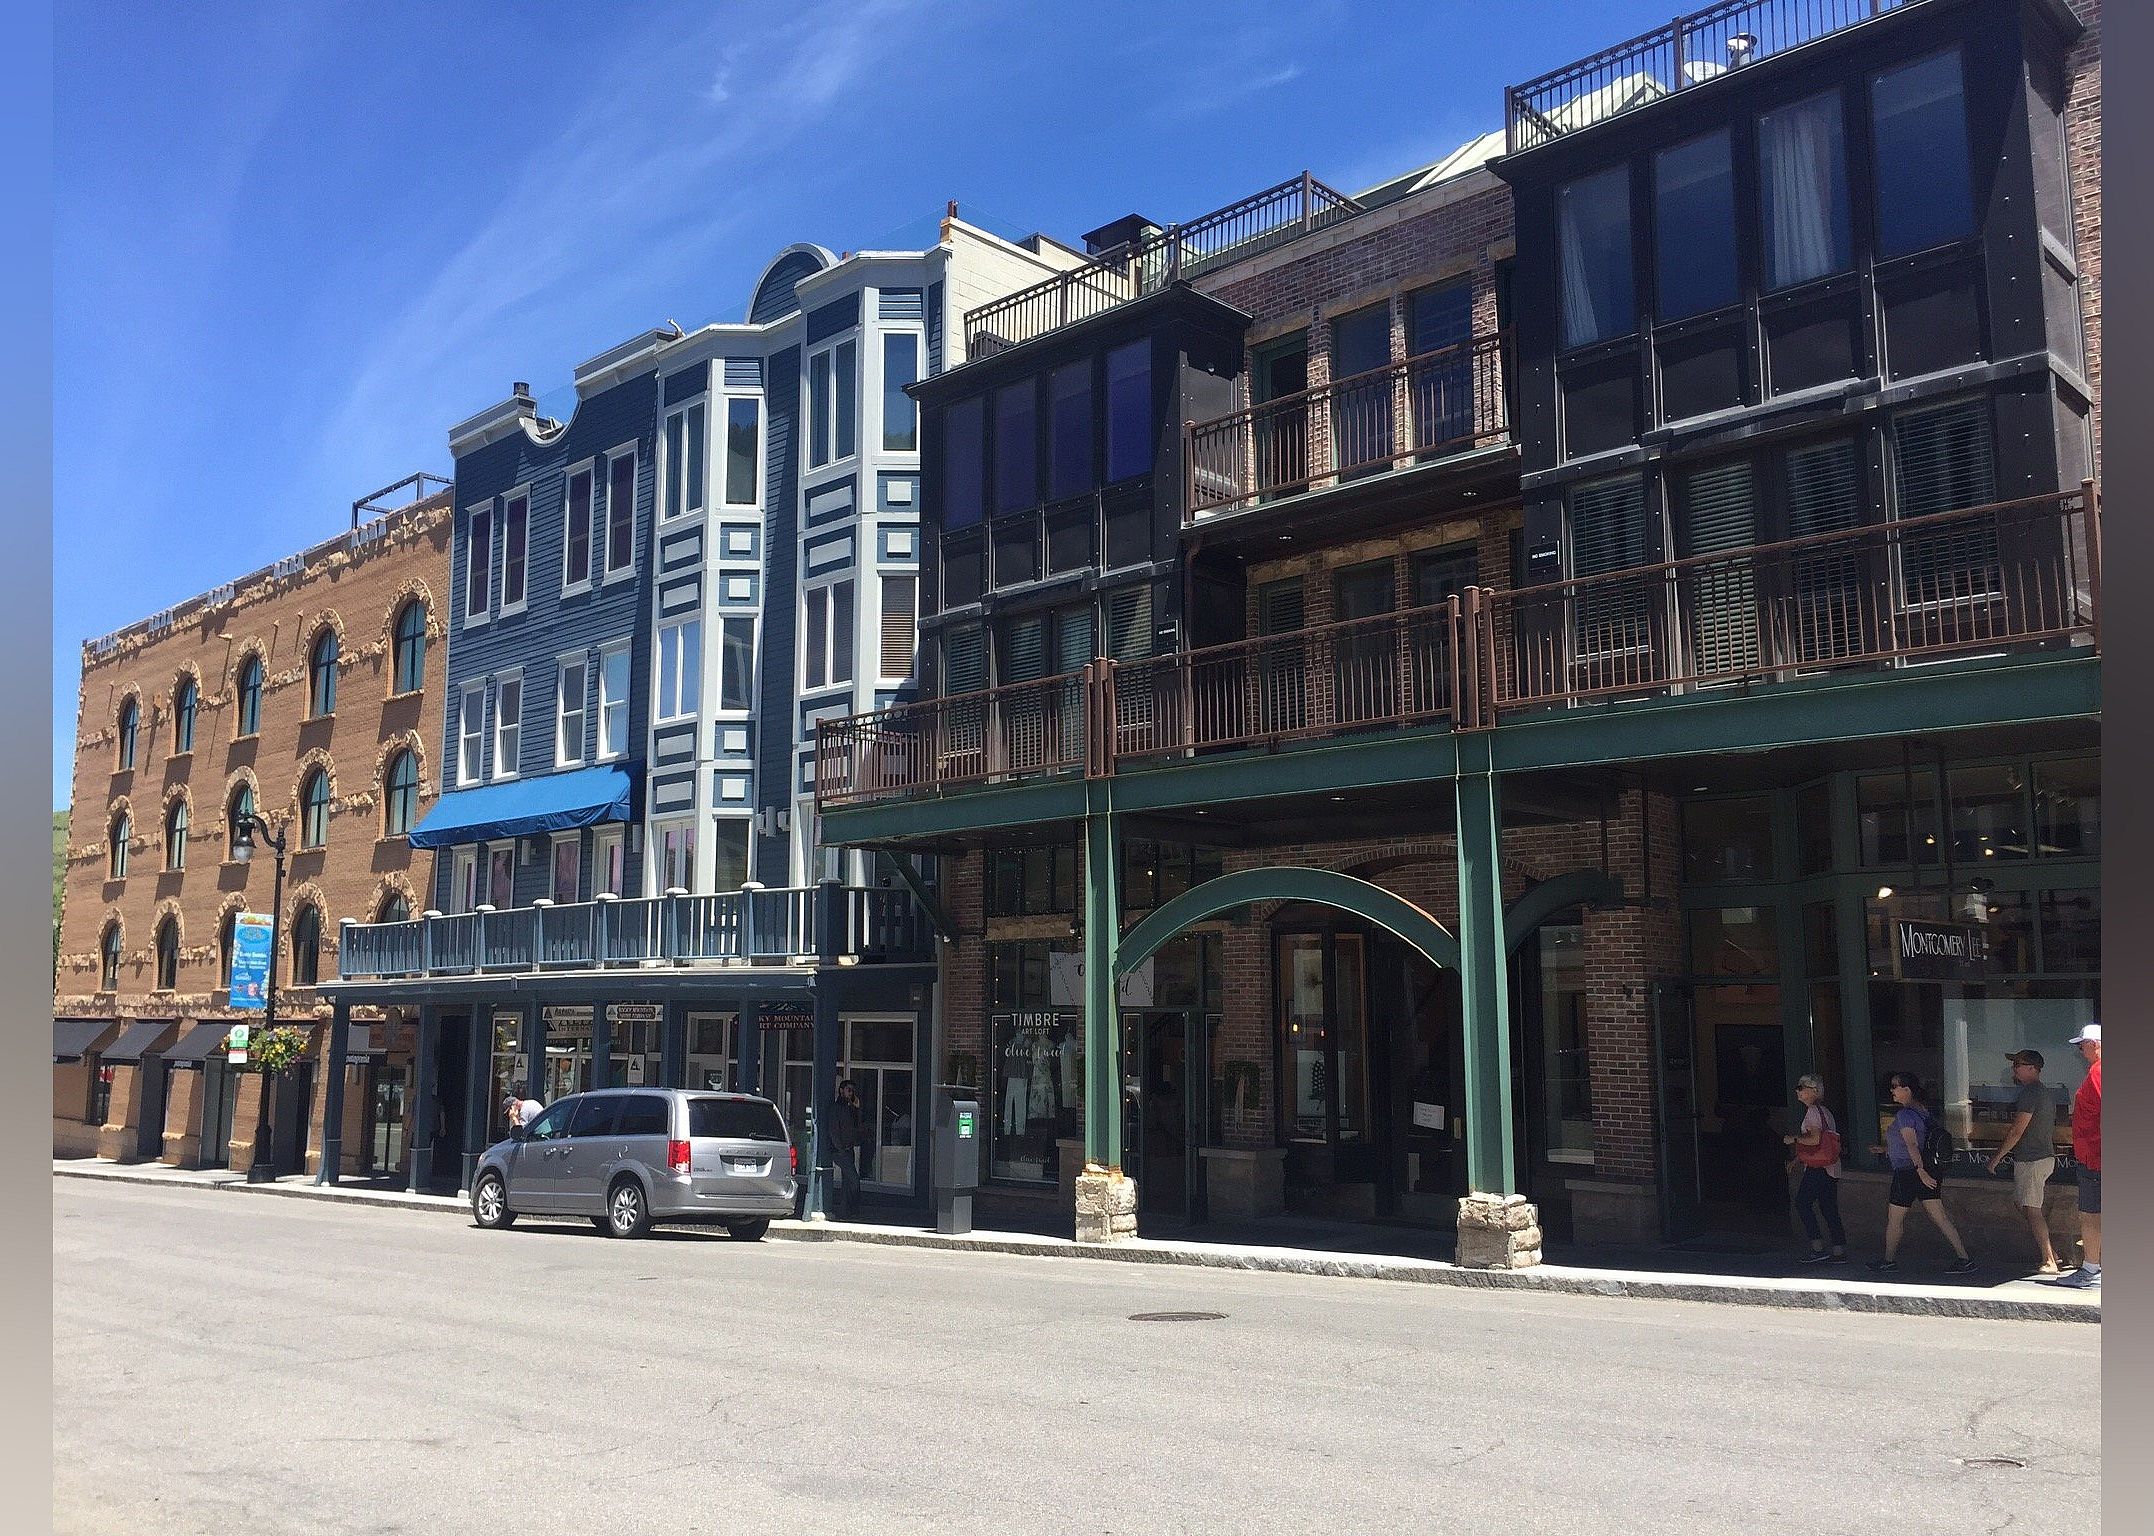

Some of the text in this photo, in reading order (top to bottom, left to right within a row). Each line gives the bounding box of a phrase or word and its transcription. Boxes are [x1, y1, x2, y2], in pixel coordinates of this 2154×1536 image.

[1011, 1013, 1060, 1027] TIMBRE
[1022, 1027, 1050, 1036] ART LOFT
